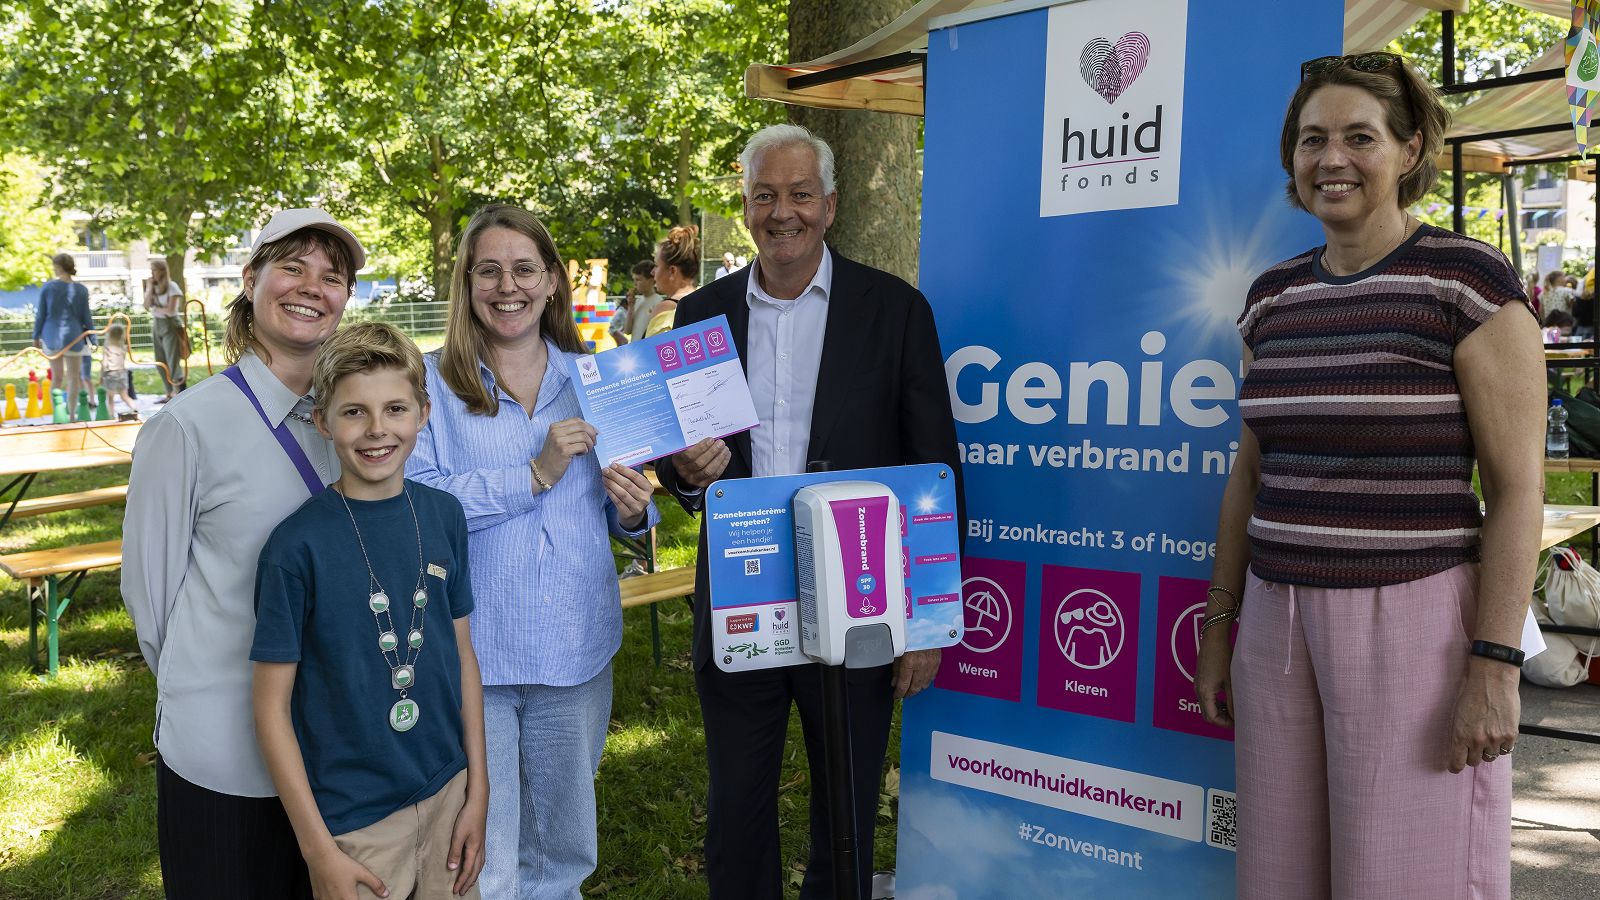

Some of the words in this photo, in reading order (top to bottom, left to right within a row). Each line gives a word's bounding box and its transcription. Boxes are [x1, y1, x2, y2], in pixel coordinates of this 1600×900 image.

[1061, 105, 1162, 163] huid
[1061, 166, 1159, 191] fonds
[585, 380, 620, 396] Gemeente
[620, 369, 657, 385] Ridderkerk
[944, 331, 1243, 428] Genie
[1028, 439, 1189, 473] verbrand
[1202, 441, 1239, 475] ni
[713, 507, 787, 520] Zonnebrandcrème
[730, 517, 771, 528] vergeten?
[728, 529, 740, 538] Wij
[741, 527, 765, 537] helpen
[766, 527, 774, 536] je
[731, 538, 745, 546] een
[858, 506, 869, 571] Zonnebrand
[968, 519, 994, 544] Bij
[998, 523, 1105, 549] zonkracht
[1110, 531, 1126, 549] 3
[1131, 532, 1156, 552] of
[1161, 533, 1217, 562] hoge
[737, 621, 754, 630] KWF
[772, 620, 789, 630] huid
[774, 639, 790, 647] GGD
[958, 661, 998, 680] Weren
[1064, 679, 1108, 698] Kleren
[1178, 698, 1203, 714] Sm
[948, 754, 1182, 821] voorkomhuidkanker.nl
[1018, 821, 1143, 871] #Zonvenant
